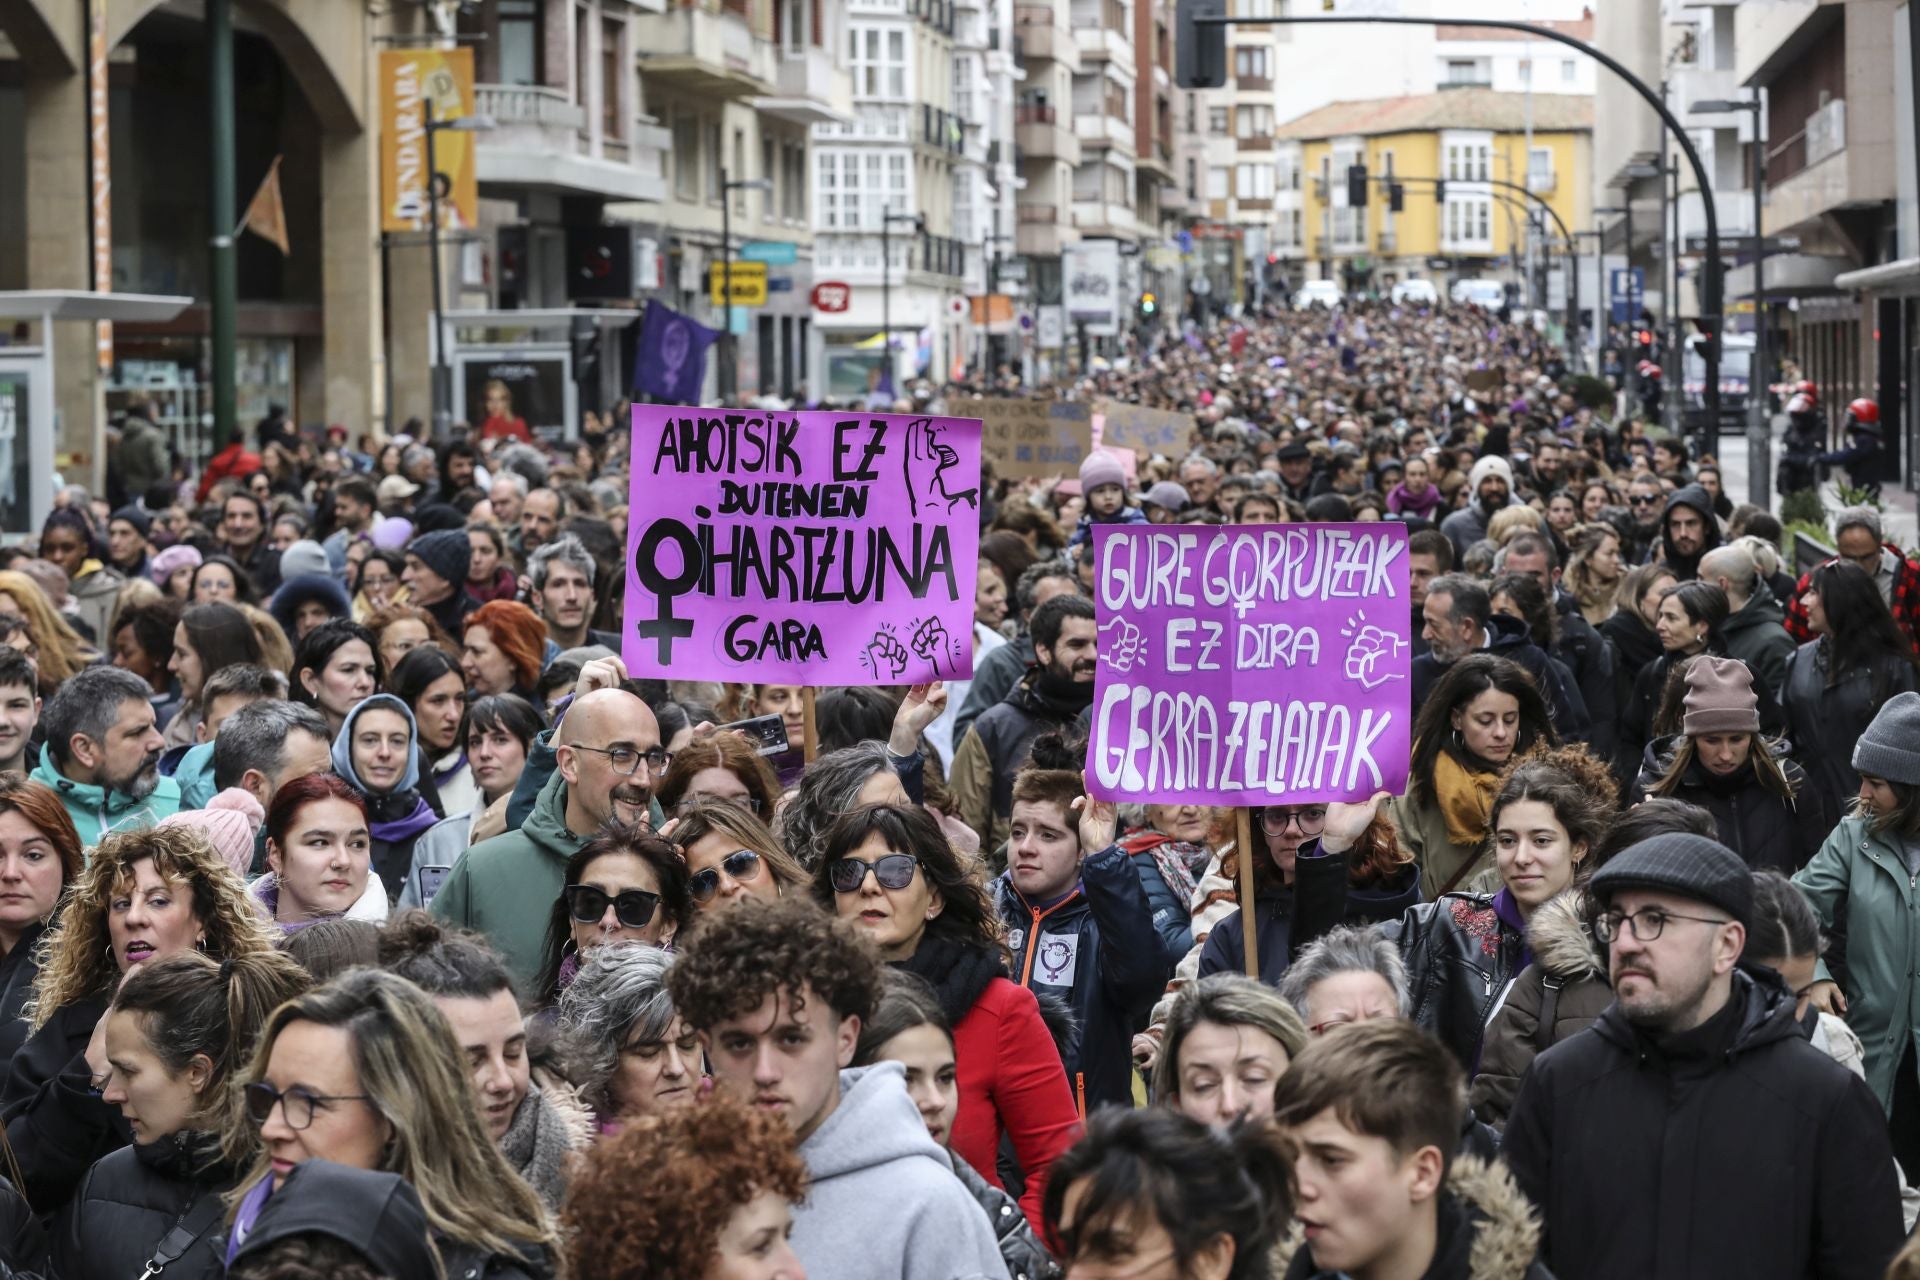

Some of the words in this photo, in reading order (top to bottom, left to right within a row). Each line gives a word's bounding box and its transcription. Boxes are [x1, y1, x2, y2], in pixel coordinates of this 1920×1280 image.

[833, 420, 887, 482] EZ
[718, 480, 869, 518] DUTENEN
[1101, 532, 1198, 610] GURE
[724, 614, 828, 662] GARA
[1166, 617, 1224, 672] EZ
[1236, 623, 1320, 670] DIRA
